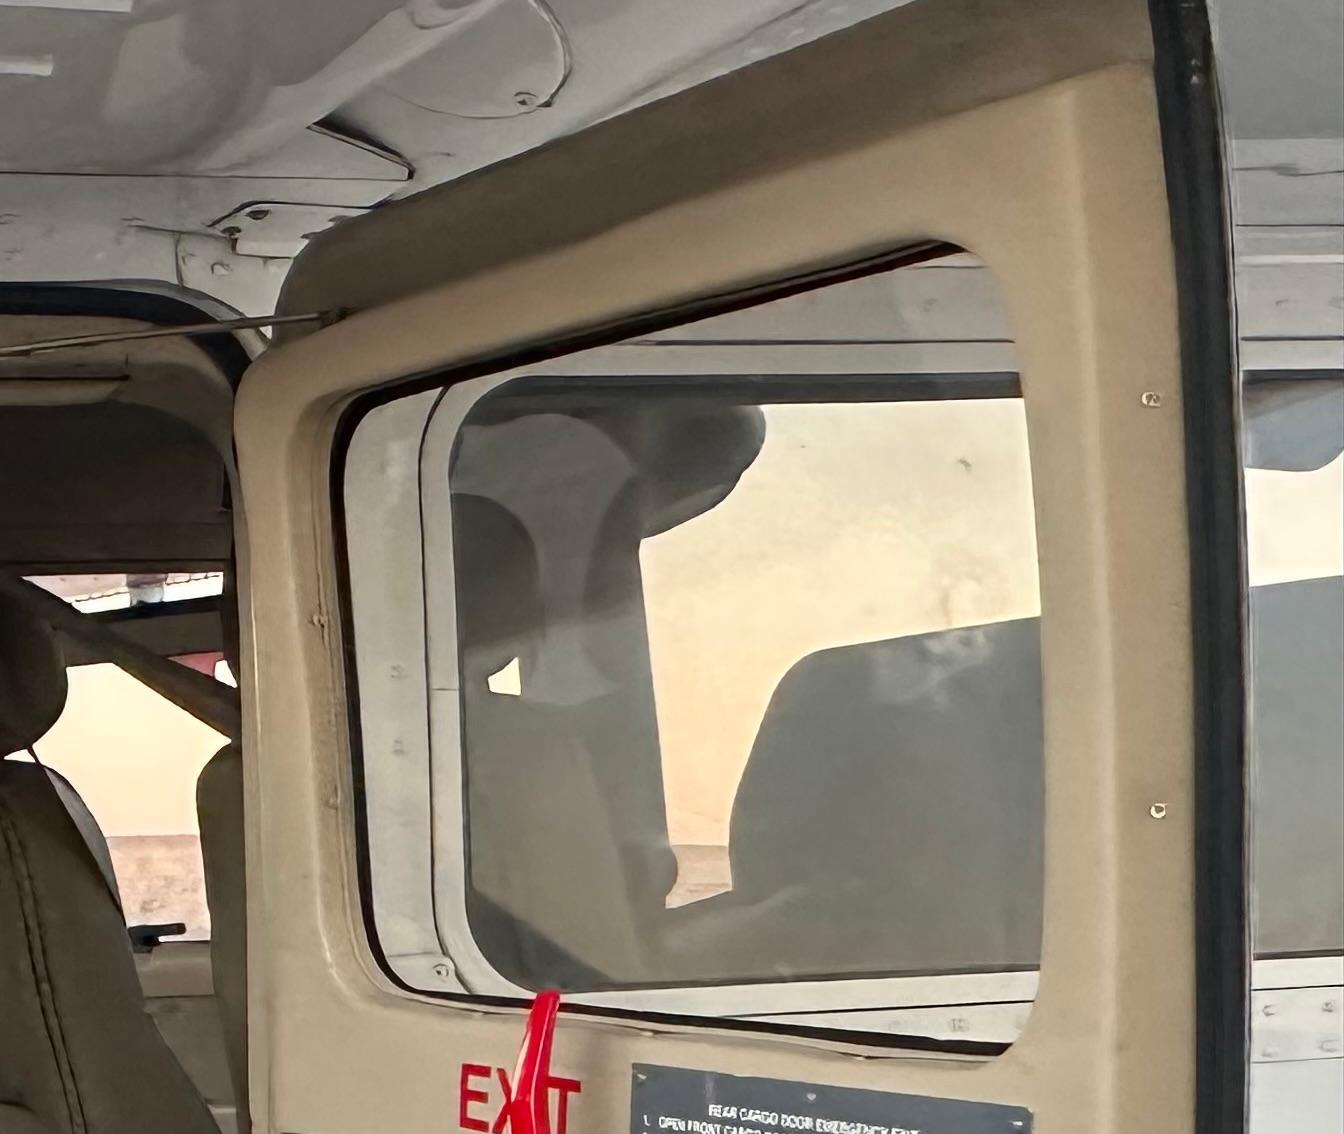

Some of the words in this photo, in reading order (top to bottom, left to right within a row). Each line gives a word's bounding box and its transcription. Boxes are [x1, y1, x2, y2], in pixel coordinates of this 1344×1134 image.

[658, 1116, 686, 1131] OPEN
[708, 1104, 737, 1119] REAR
[739, 1108, 778, 1125] CARGO
[781, 1113, 814, 1131] DOOR
